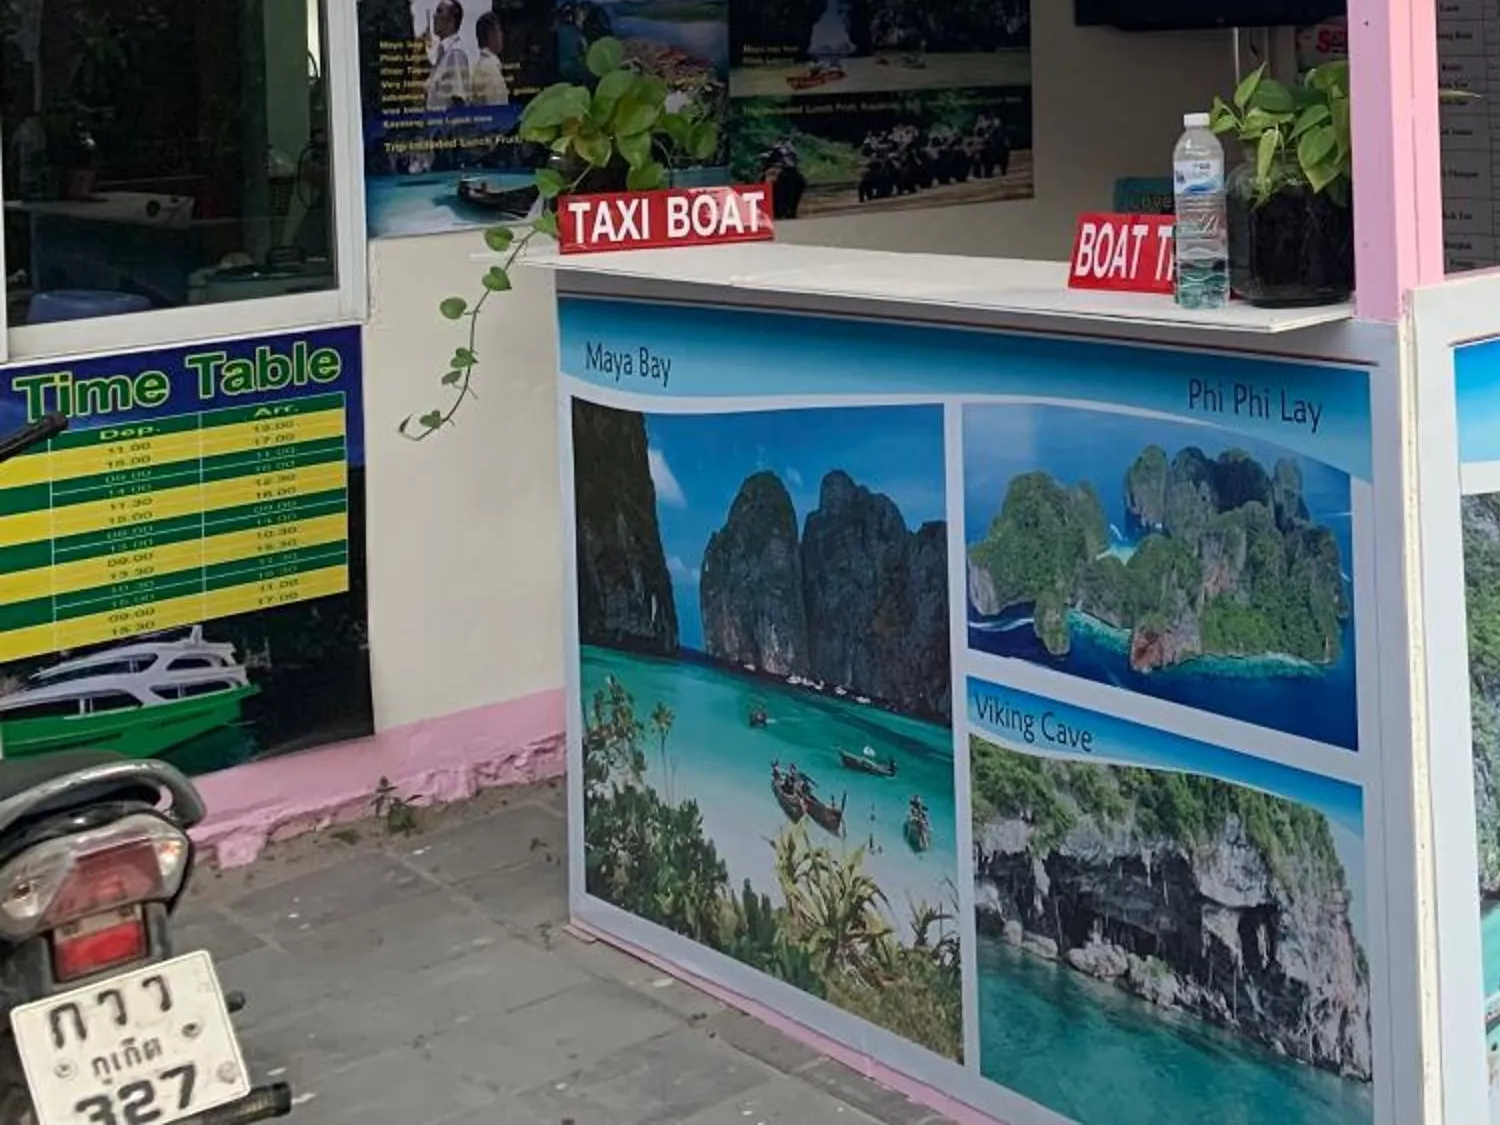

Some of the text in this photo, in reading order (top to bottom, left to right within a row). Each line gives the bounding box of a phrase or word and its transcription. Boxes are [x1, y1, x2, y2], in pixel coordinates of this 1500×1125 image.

[568, 191, 765, 244] TAXI BOAT
[1074, 222, 1149, 279] BOAT
[12, 341, 341, 425] Time Table
[585, 343, 672, 387] Maya Bay
[99, 403, 300, 441] Dep. Arr.
[1188, 378, 1323, 433] Phi Phi Lay
[973, 694, 1093, 752] Viking Cave
[74, 1063, 196, 1125] 327
